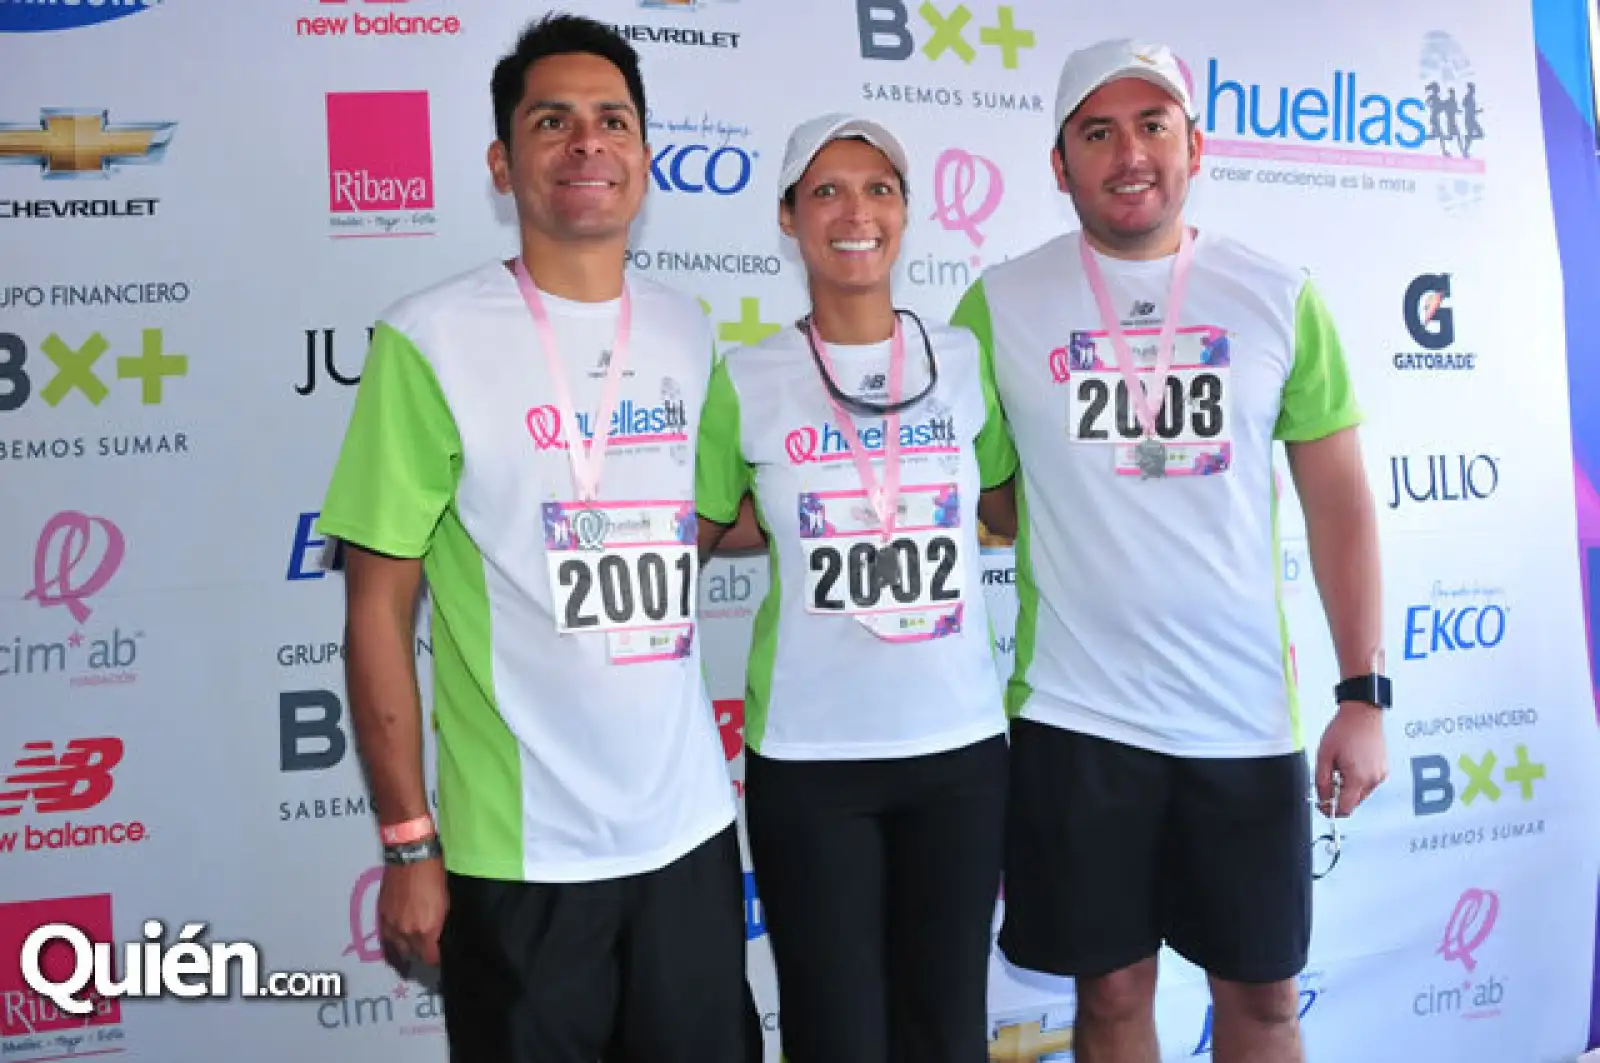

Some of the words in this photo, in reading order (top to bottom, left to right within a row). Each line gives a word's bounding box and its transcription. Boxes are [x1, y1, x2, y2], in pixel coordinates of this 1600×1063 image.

[296, 17, 348, 36] new
[354, 12, 461, 36] balance
[862, 82, 963, 107] SABEMOS
[972, 93, 1044, 112] SUMAR
[1206, 57, 1427, 149] huellas
[333, 169, 427, 212] Ribaya
[1210, 165, 1252, 182] crear
[1256, 168, 1336, 189] conciencia
[1340, 175, 1360, 190] es
[657, 251, 781, 276] FINANCIERO
[51, 282, 190, 306] FINANCIERO
[1393, 353, 1475, 370] GATORADE
[1077, 372, 1224, 441] 2003
[99, 433, 189, 456] SUMAR
[1388, 454, 1500, 509] JULIO
[809, 536, 960, 610] 2002
[558, 551, 691, 628] 2001
[1404, 604, 1506, 661] EKCO
[25, 820, 146, 851] balance
[1409, 826, 1485, 853] SABEMOS
[1491, 819, 1546, 842] SUMAR
